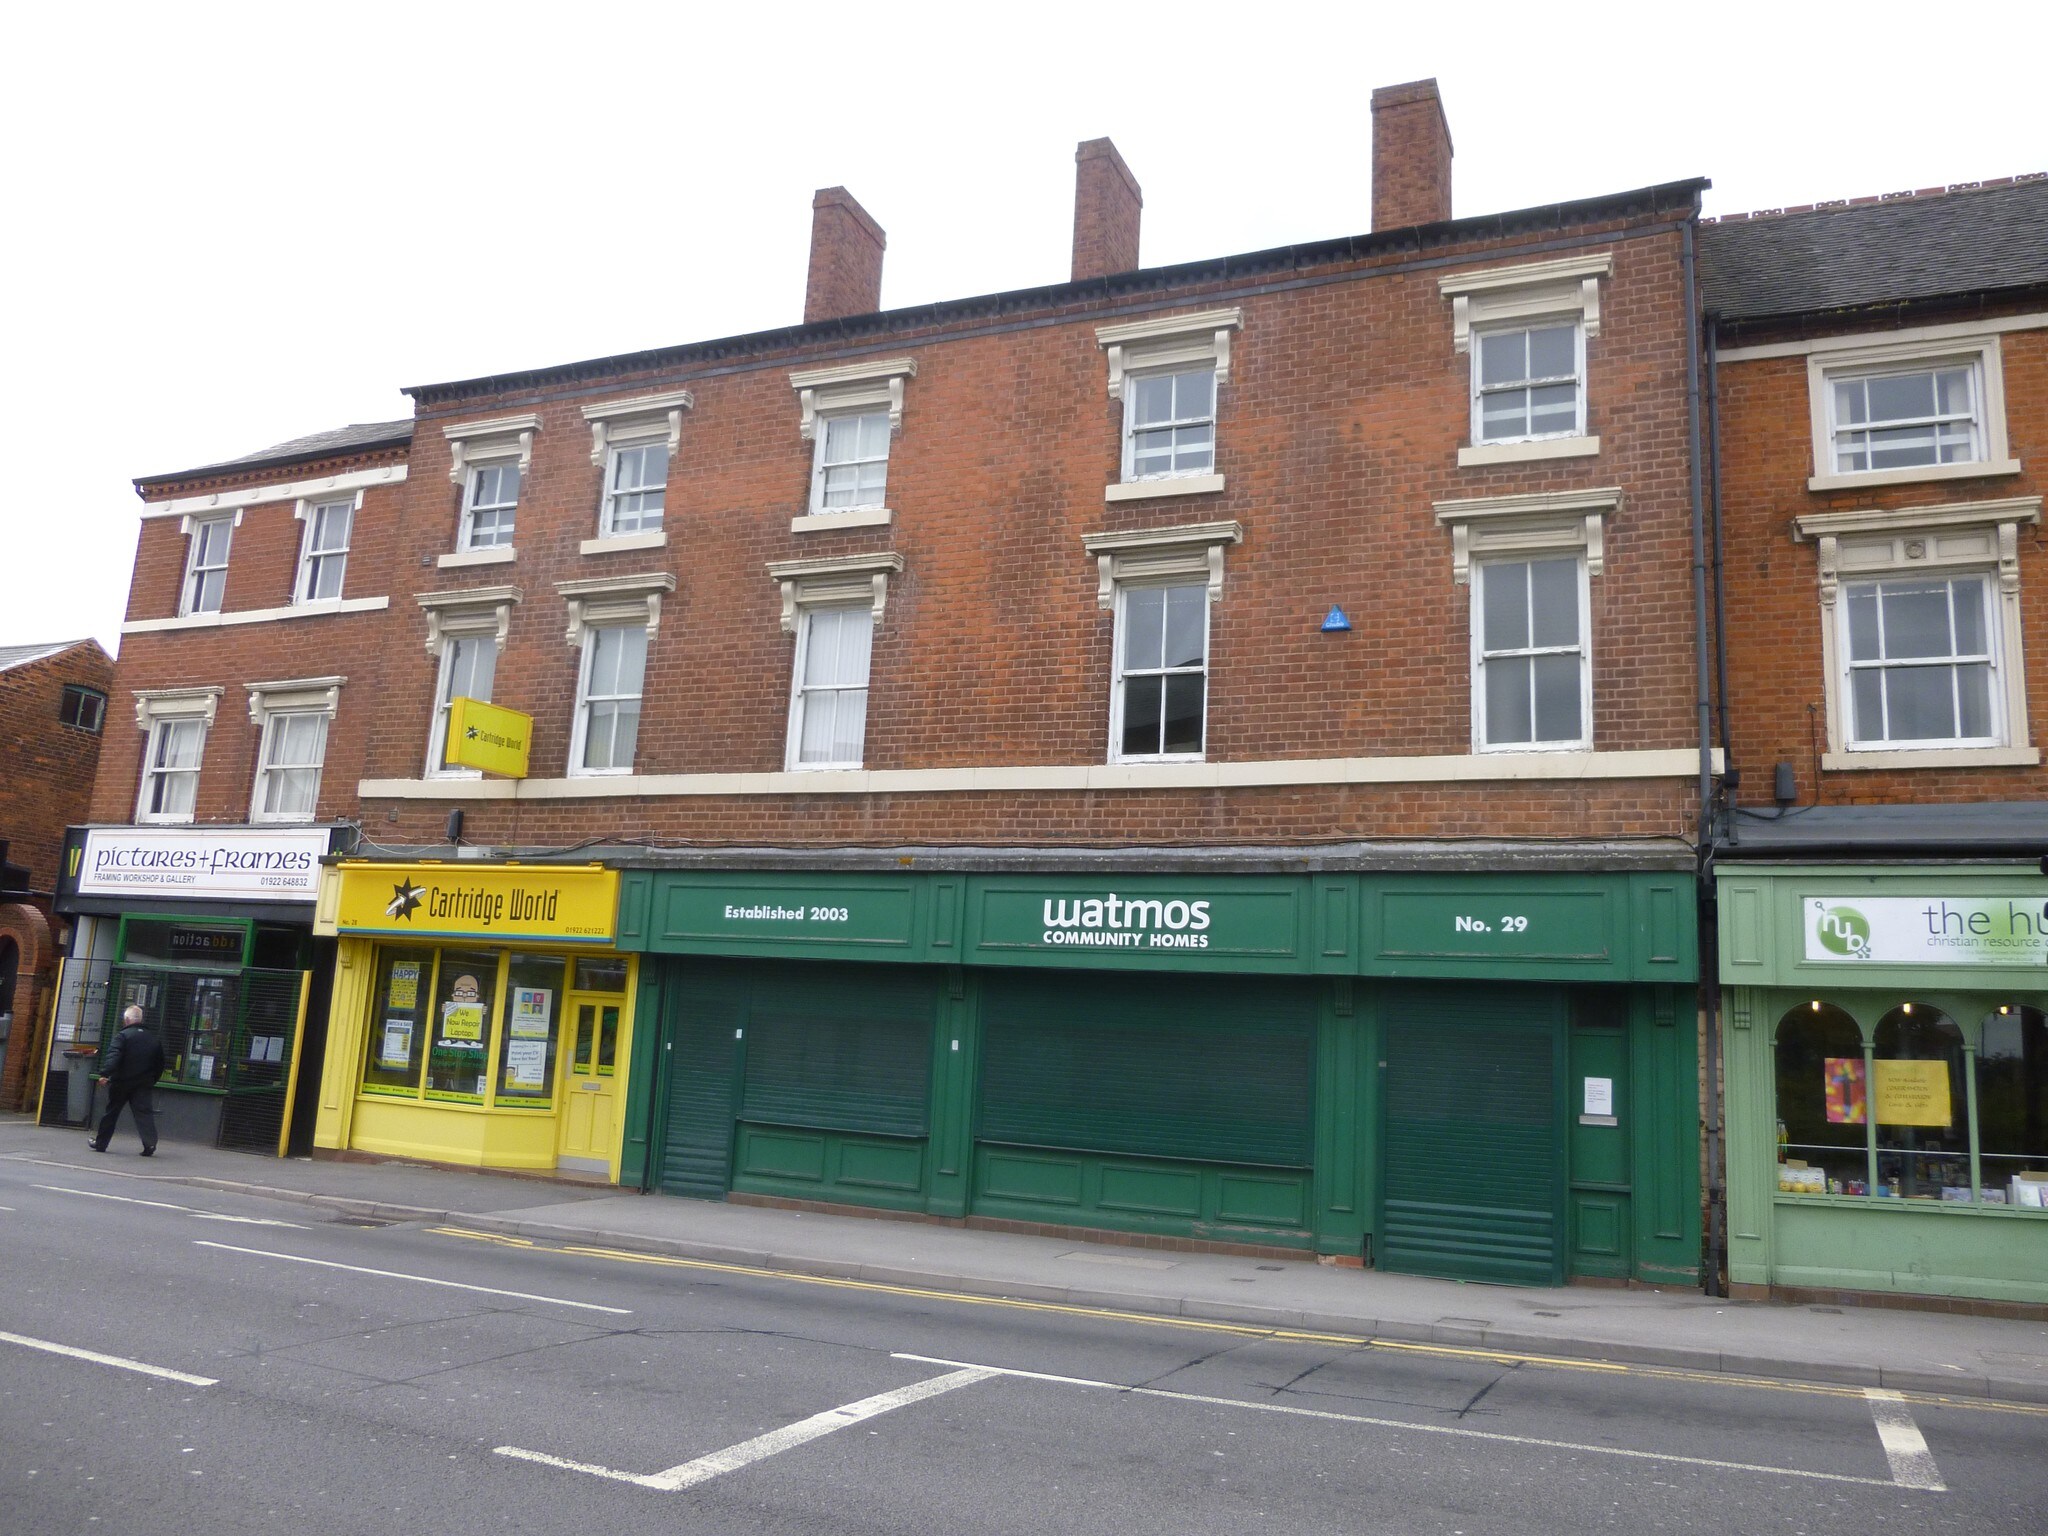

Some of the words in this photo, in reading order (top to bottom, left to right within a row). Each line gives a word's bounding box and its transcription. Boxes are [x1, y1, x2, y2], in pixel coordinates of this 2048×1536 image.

[480, 730, 505, 748] Cartridge
[506, 737, 522, 750] World
[94, 873, 122, 882] FRAMING
[123, 874, 160, 883] WORKSHOP
[160, 875, 164, 883] &
[166, 875, 197, 884] GALLERY
[260, 876, 282, 886] 01922
[282, 878, 308, 887] 648832
[429, 886, 504, 926] Cartridge
[509, 888, 559, 921] World
[725, 905, 805, 920] Established
[810, 906, 849, 921] 2003
[1043, 892, 1211, 930] watmos
[1455, 916, 1491, 932] No.
[1501, 916, 1528, 932] 29
[1922, 901, 1991, 935] the
[1822, 909, 1865, 951] hub
[1043, 930, 1143, 946] COMMUNITY
[1150, 934, 1209, 948] HOMES
[1927, 936, 1979, 948] christian
[1984, 938, 2040, 948] resource
[393, 968, 418, 980] HAPPY
[461, 1019, 480, 1028] Repair
[450, 1029, 474, 1037] Laptops
